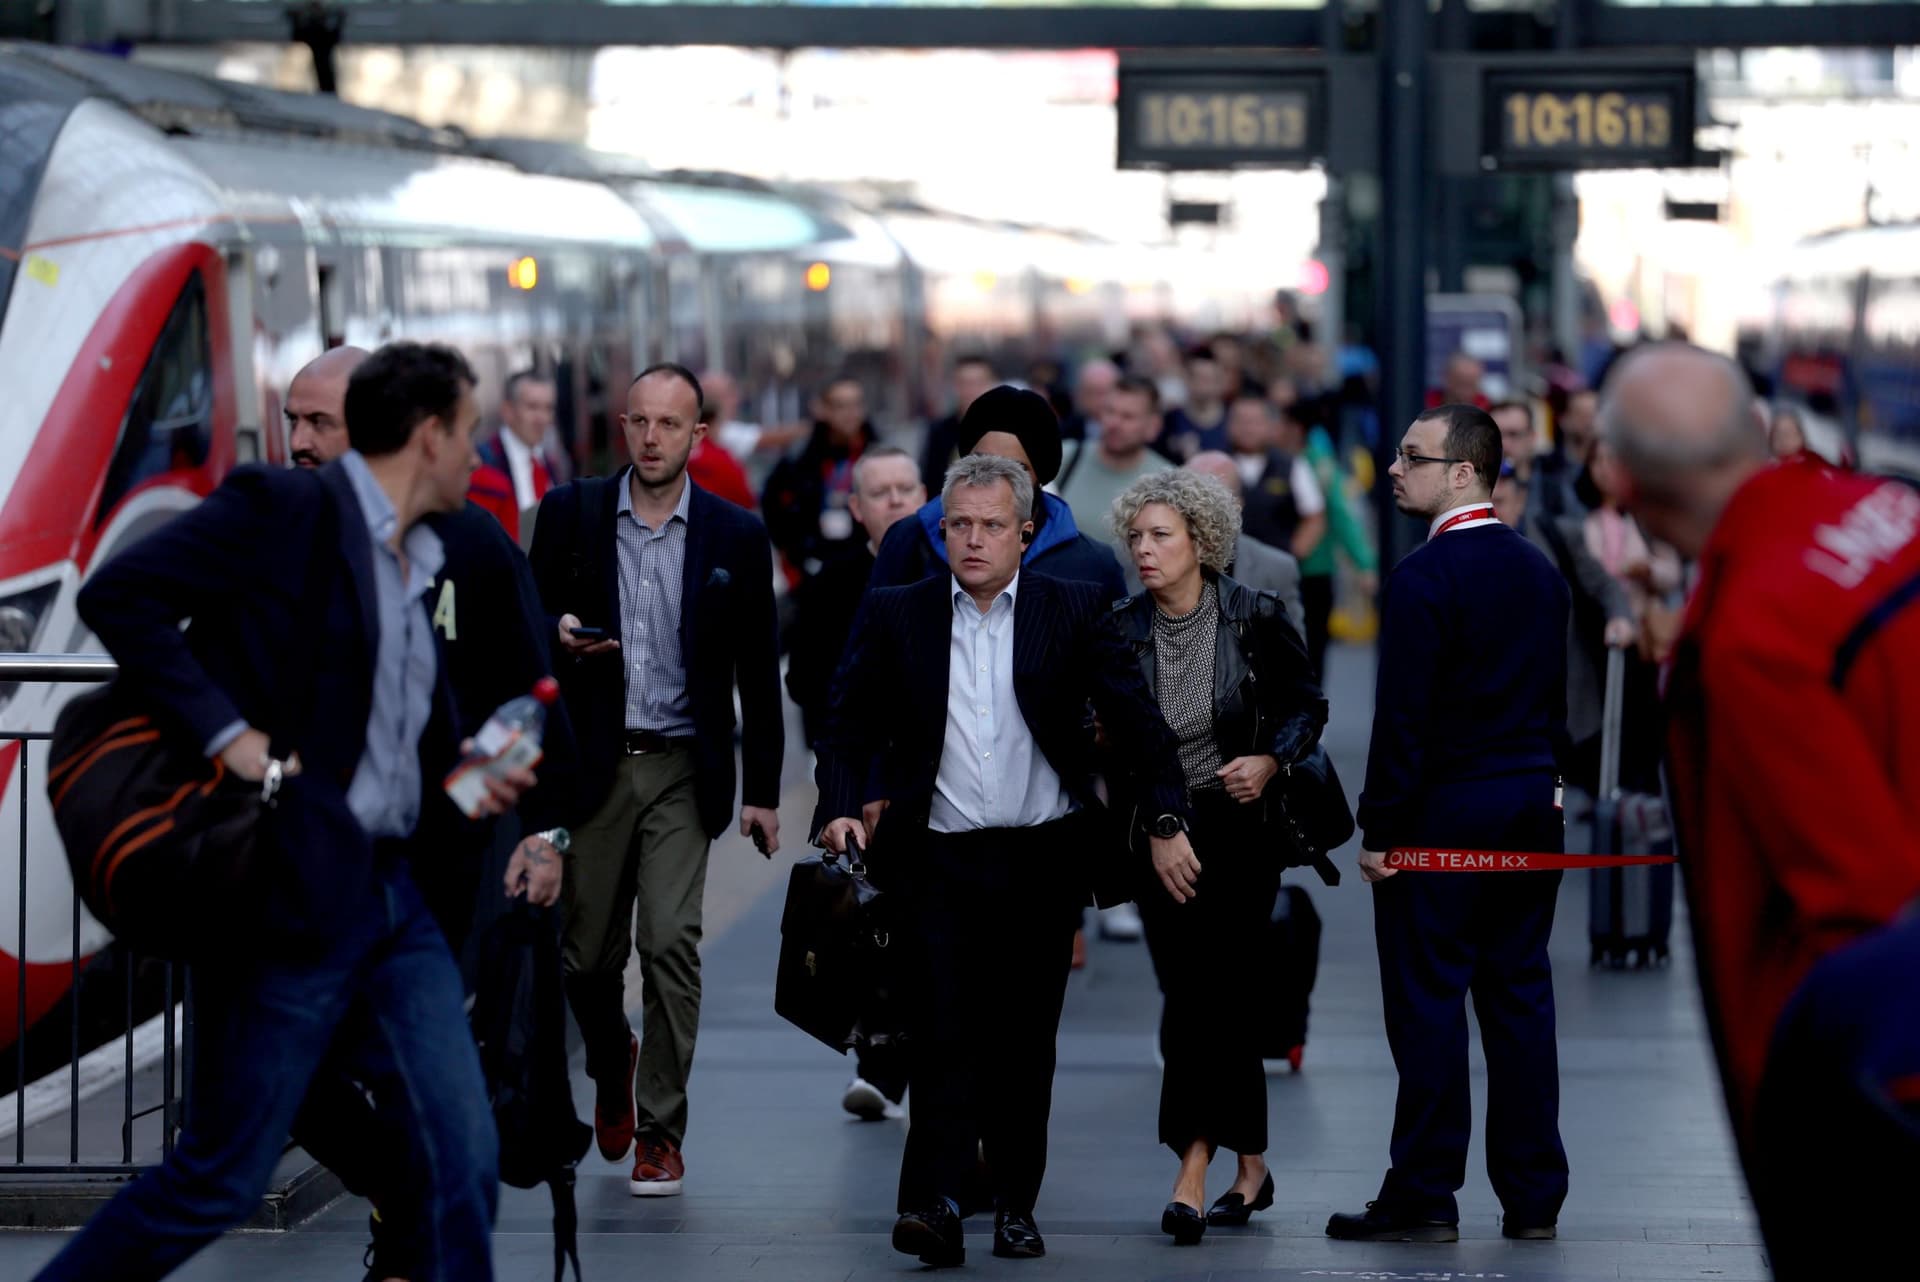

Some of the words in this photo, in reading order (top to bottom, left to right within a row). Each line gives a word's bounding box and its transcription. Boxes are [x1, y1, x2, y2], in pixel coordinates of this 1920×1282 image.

[1144, 95, 1259, 146] 10:16
[1507, 93, 1624, 146] 10:16
[1389, 851, 1430, 867] ONE
[1436, 853, 1494, 868] TEAM
[1501, 855, 1529, 868] KX
